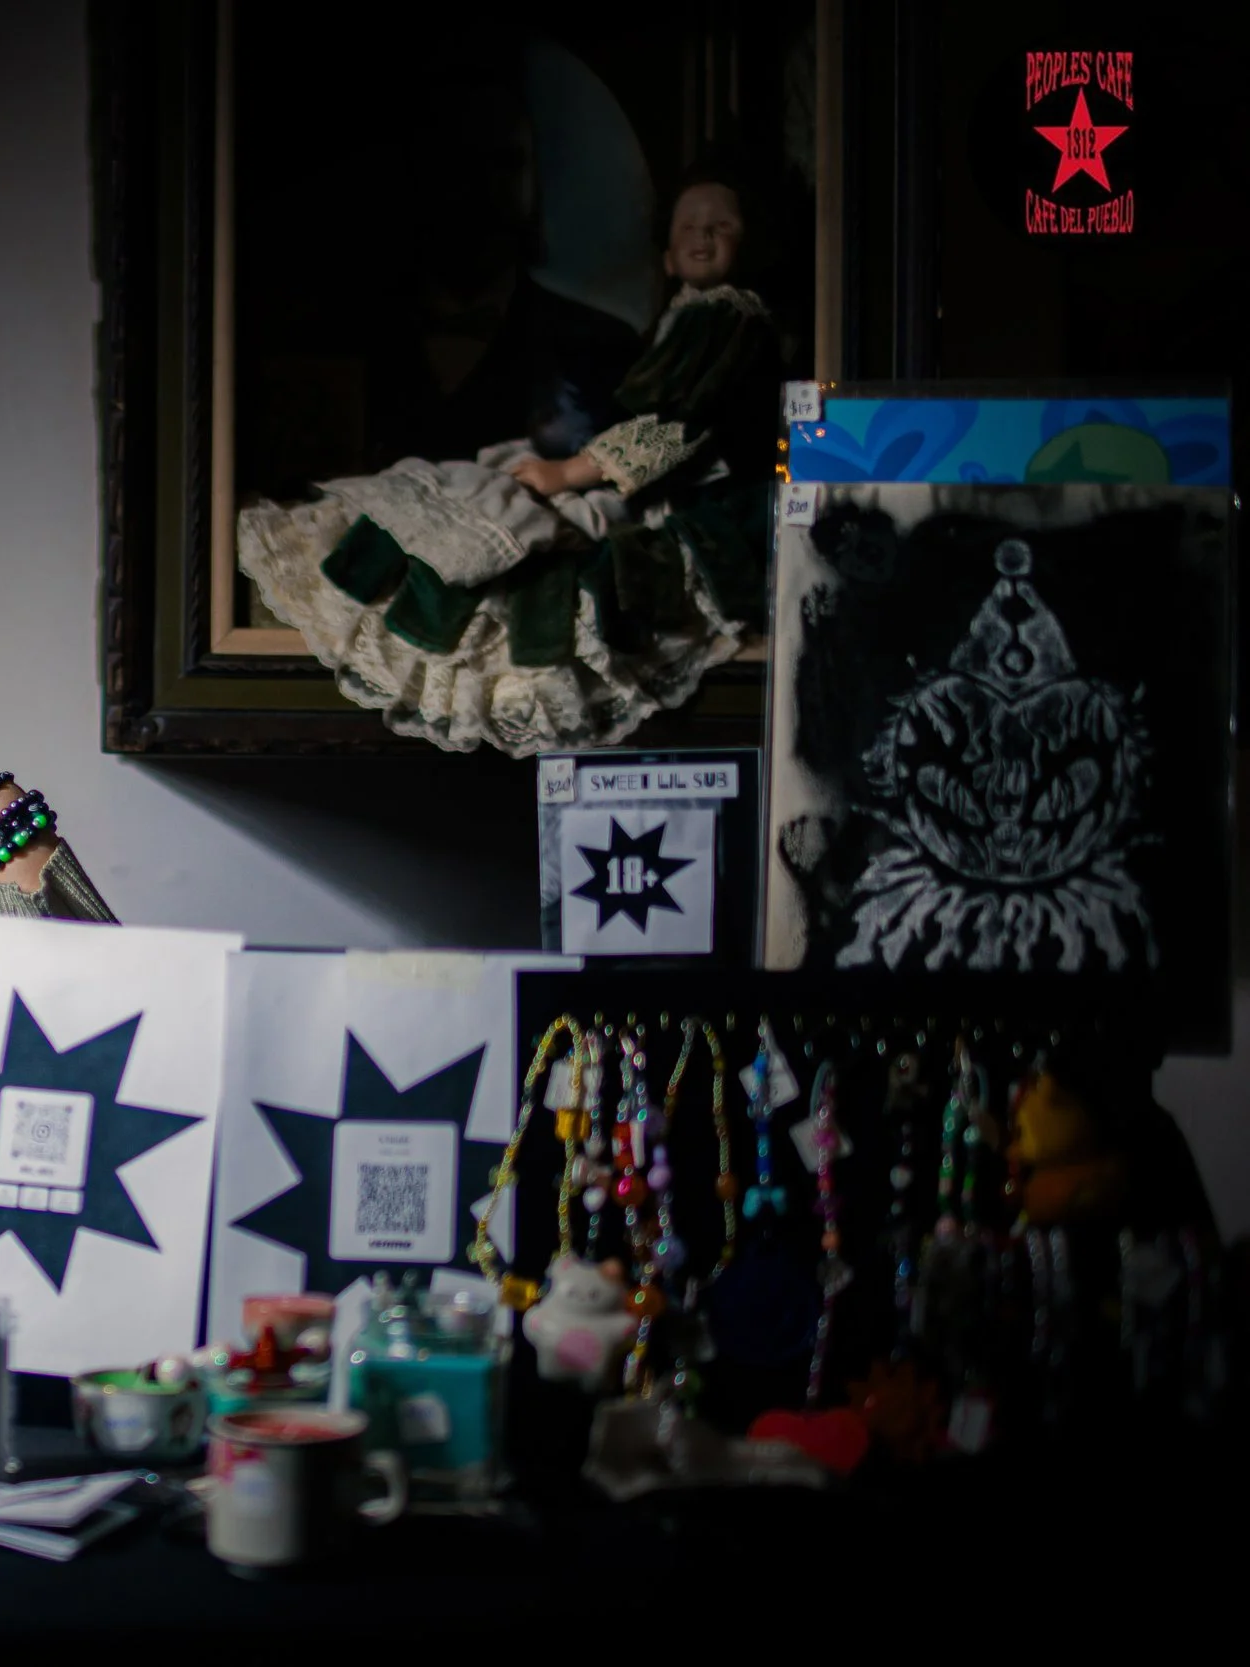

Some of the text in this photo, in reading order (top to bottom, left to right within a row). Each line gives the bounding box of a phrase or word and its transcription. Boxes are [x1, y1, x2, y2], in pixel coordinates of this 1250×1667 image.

[590, 771, 729, 790] SWEET LIL SUB
[605, 855, 661, 895] 18+
